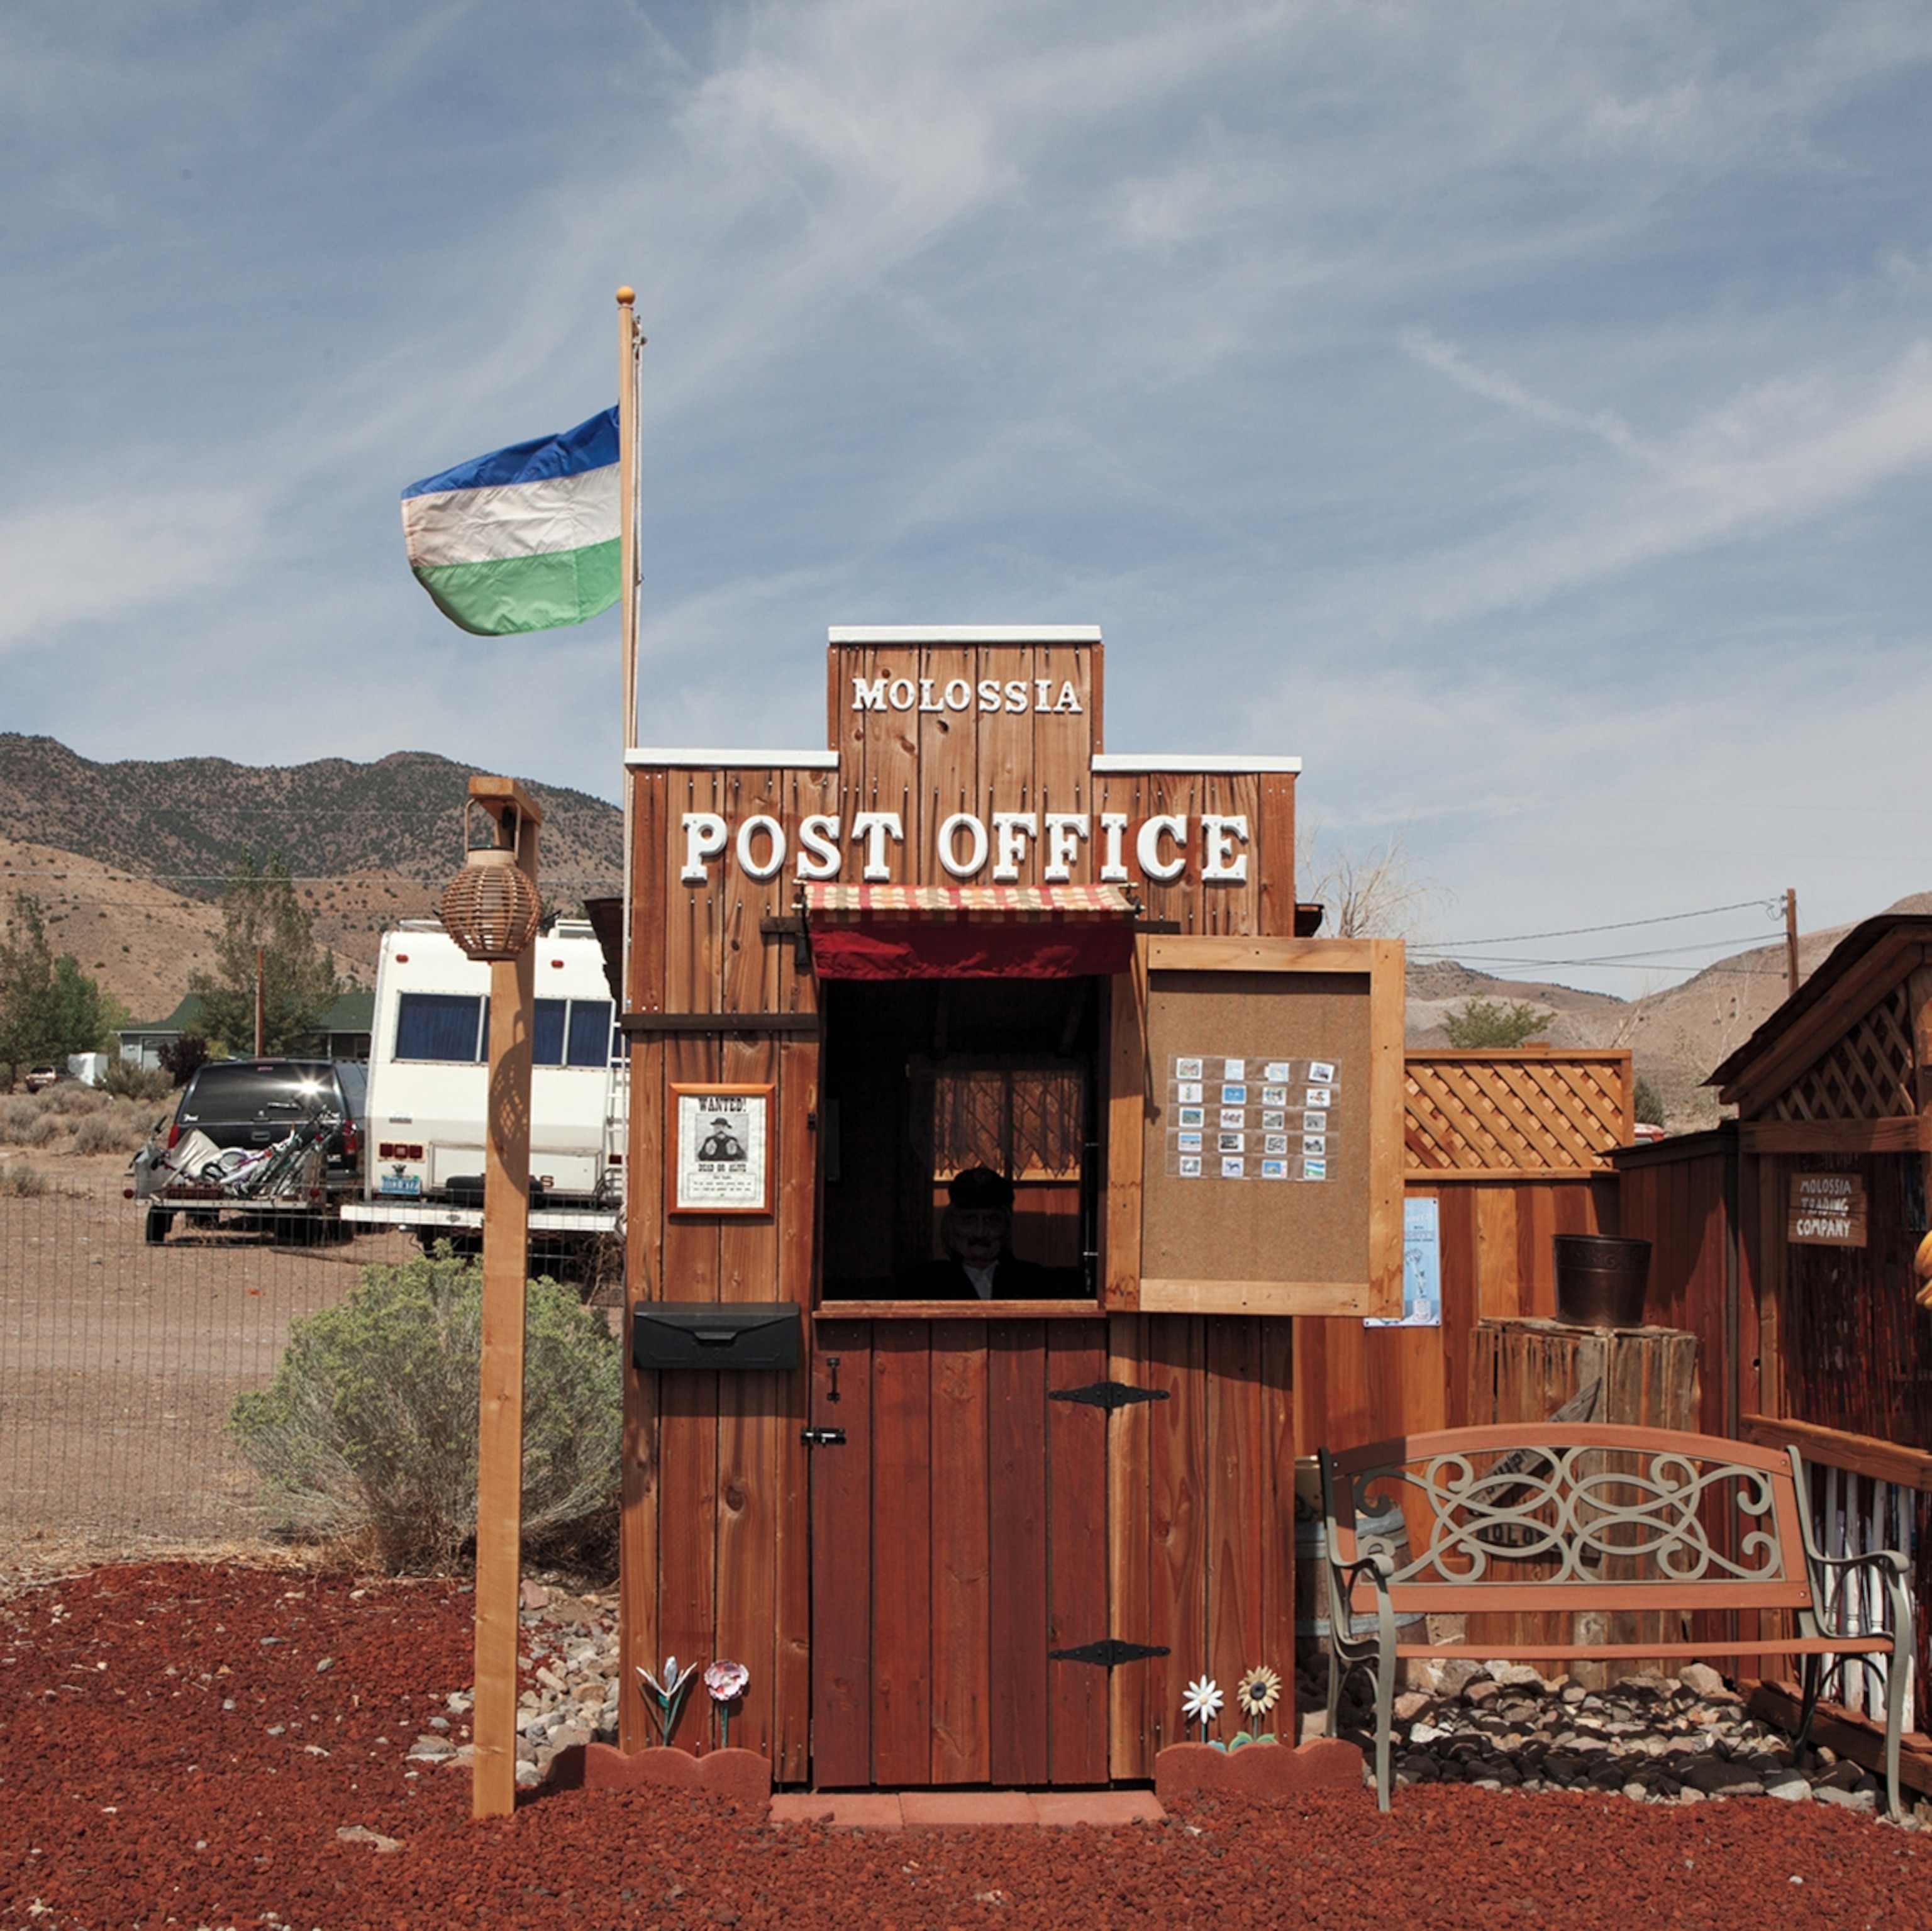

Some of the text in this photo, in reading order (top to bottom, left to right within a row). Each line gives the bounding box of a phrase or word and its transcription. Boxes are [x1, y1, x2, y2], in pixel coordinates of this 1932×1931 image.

[852, 678, 1083, 713] MOLOSSIA
[680, 812, 1250, 882] POST OFFICE
[699, 1097, 747, 1112] WANTED!
[1799, 1178, 1852, 1195] MOLOSSIA
[1801, 1198, 1849, 1216] TRADING
[1797, 1218, 1850, 1238] COMPANY
